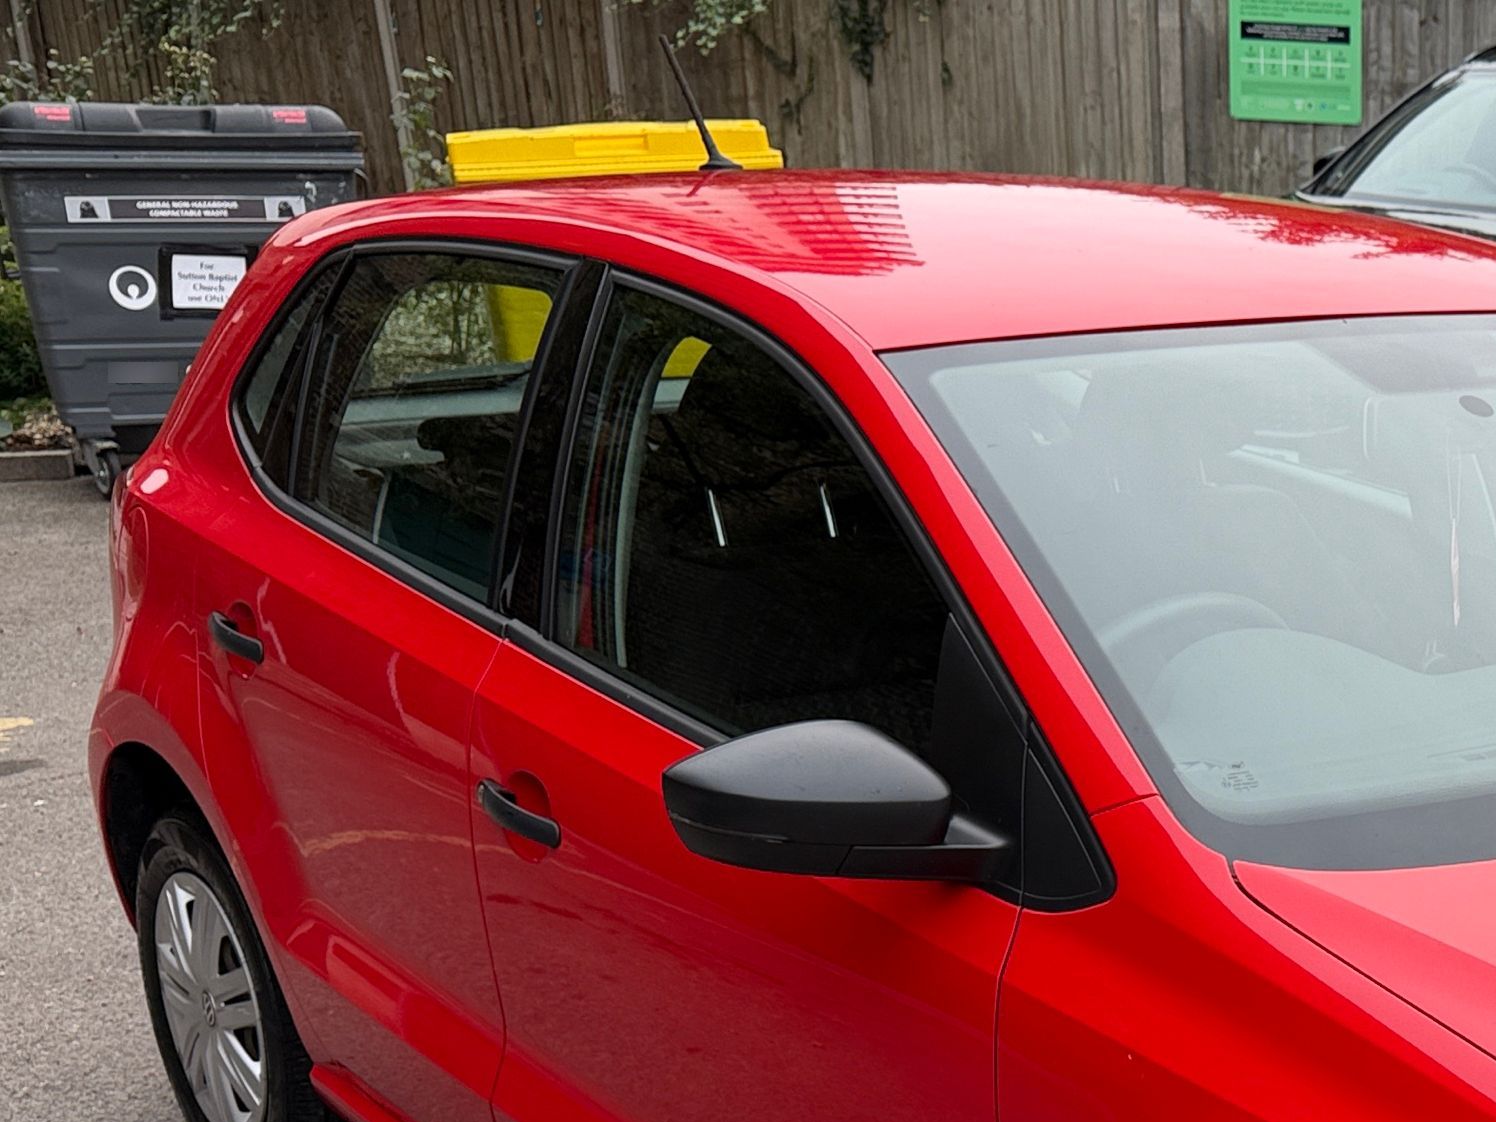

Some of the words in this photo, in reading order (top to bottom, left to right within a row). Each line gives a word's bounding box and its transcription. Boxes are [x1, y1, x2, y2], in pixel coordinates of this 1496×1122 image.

[136, 200, 171, 209] GENERAL
[200, 262, 214, 271] For
[208, 273, 238, 282] Baptist
[192, 283, 225, 292] Church
